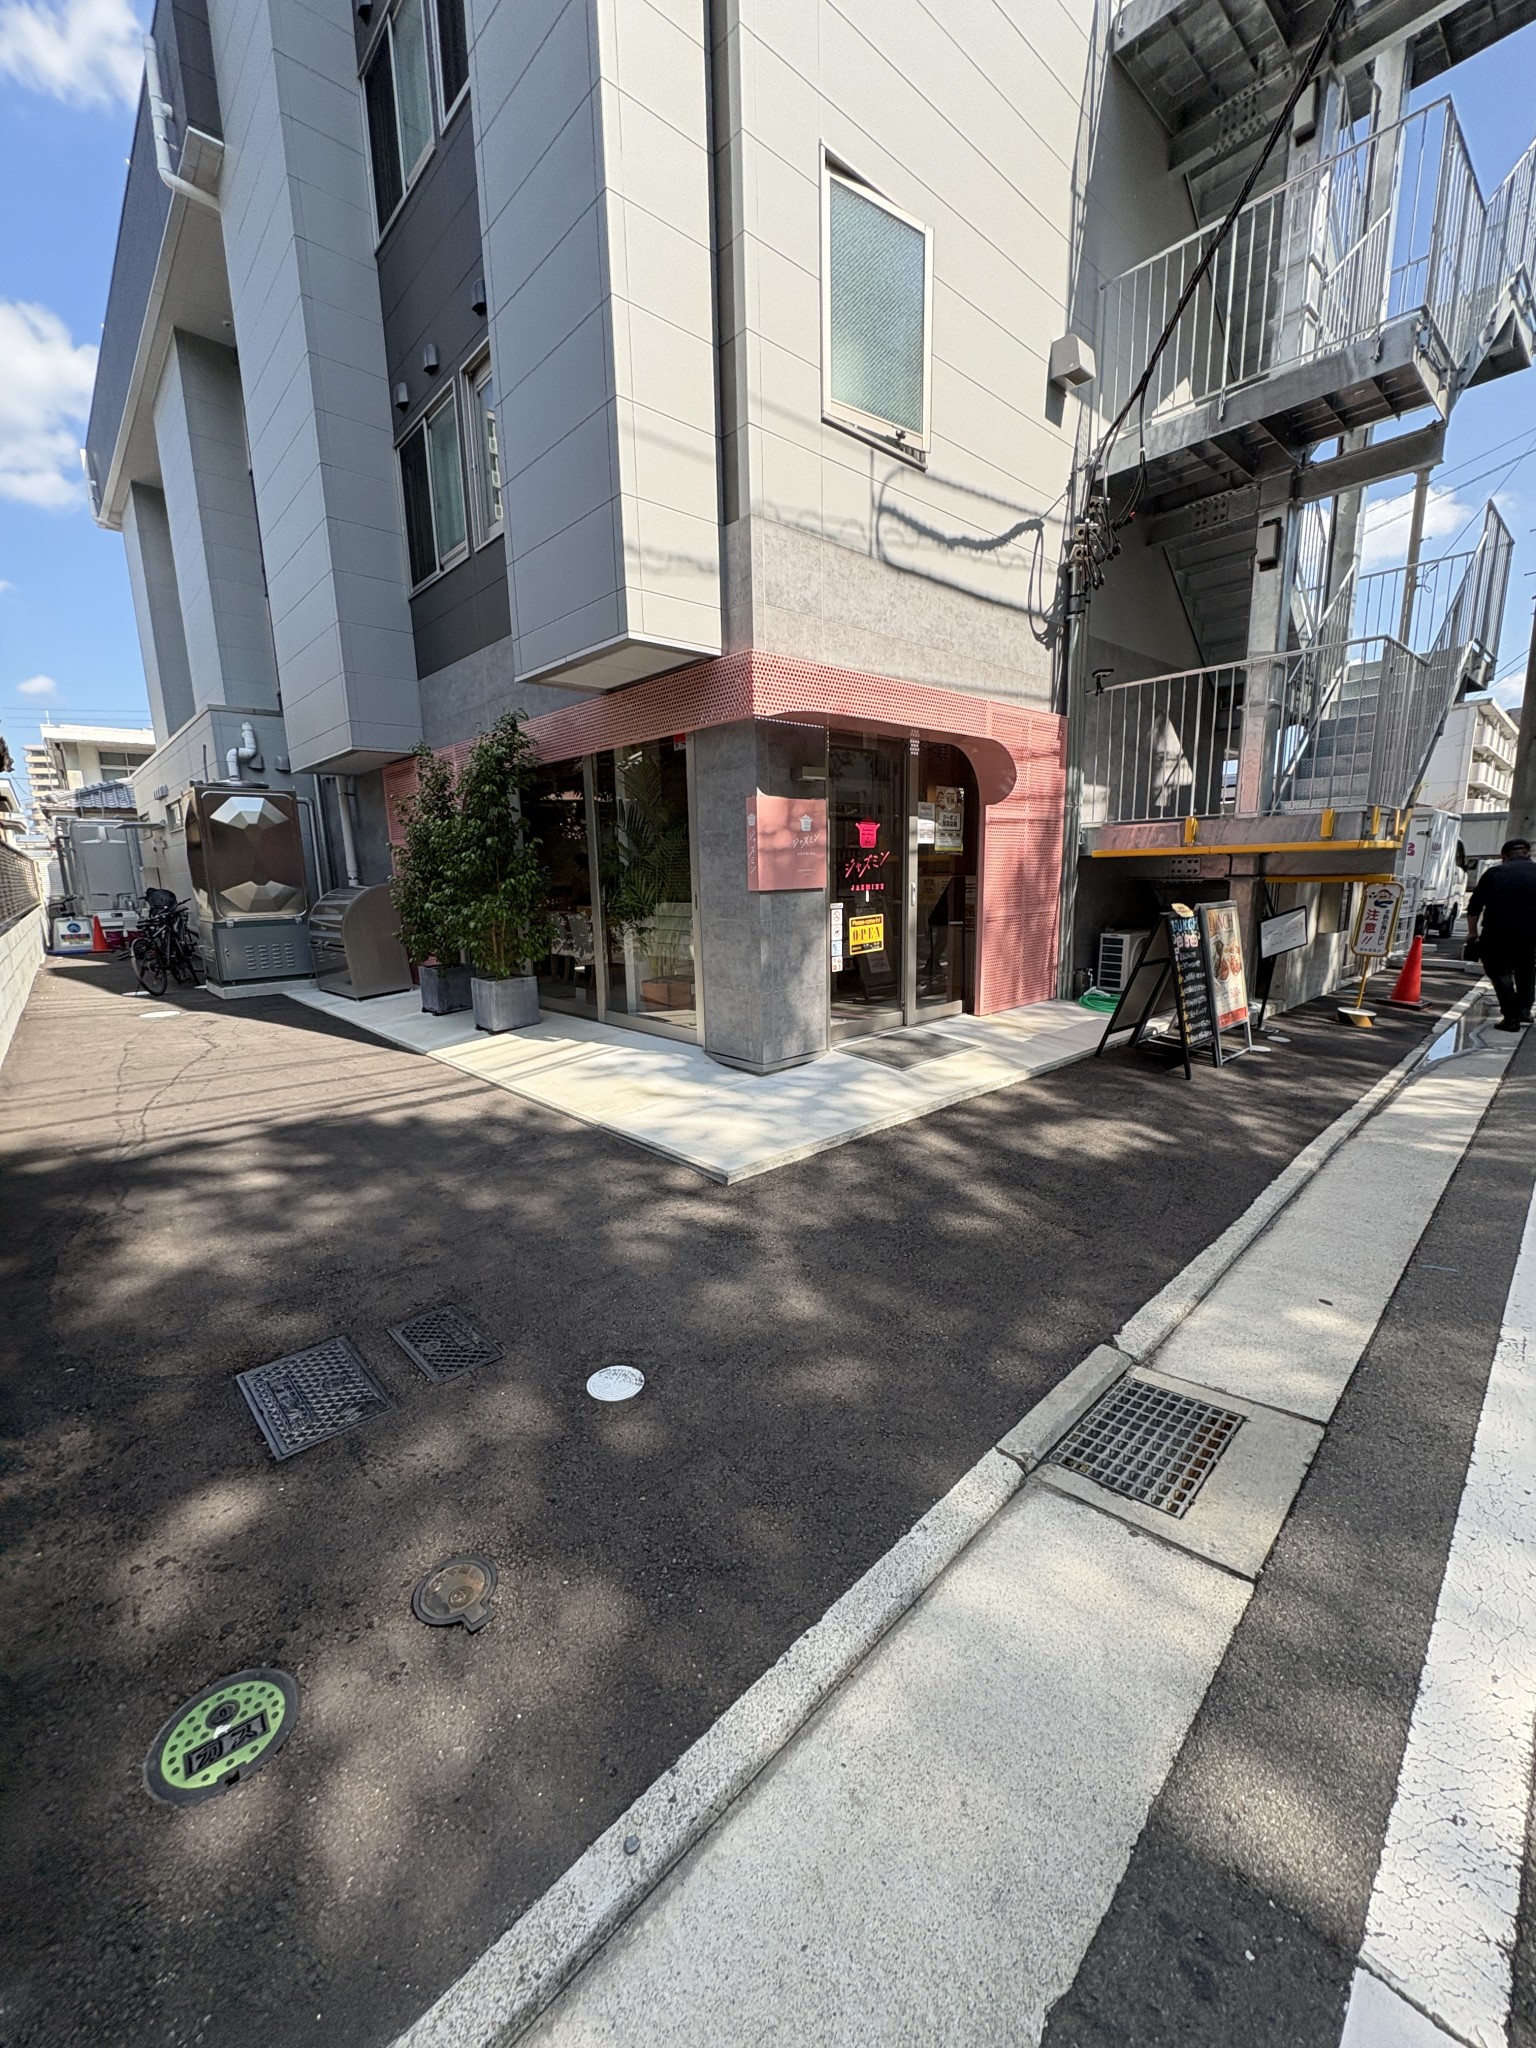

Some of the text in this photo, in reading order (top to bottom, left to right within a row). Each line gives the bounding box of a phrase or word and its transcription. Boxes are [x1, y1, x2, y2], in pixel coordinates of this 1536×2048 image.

[792, 833, 821, 849] ジャズミン
[845, 850, 891, 879] ジャズミン
[850, 883, 885, 892] JASMINE
[1208, 912, 1235, 932] LUNCH
[852, 926, 881, 942] OPEN
[195, 1722, 259, 1770] ガス
